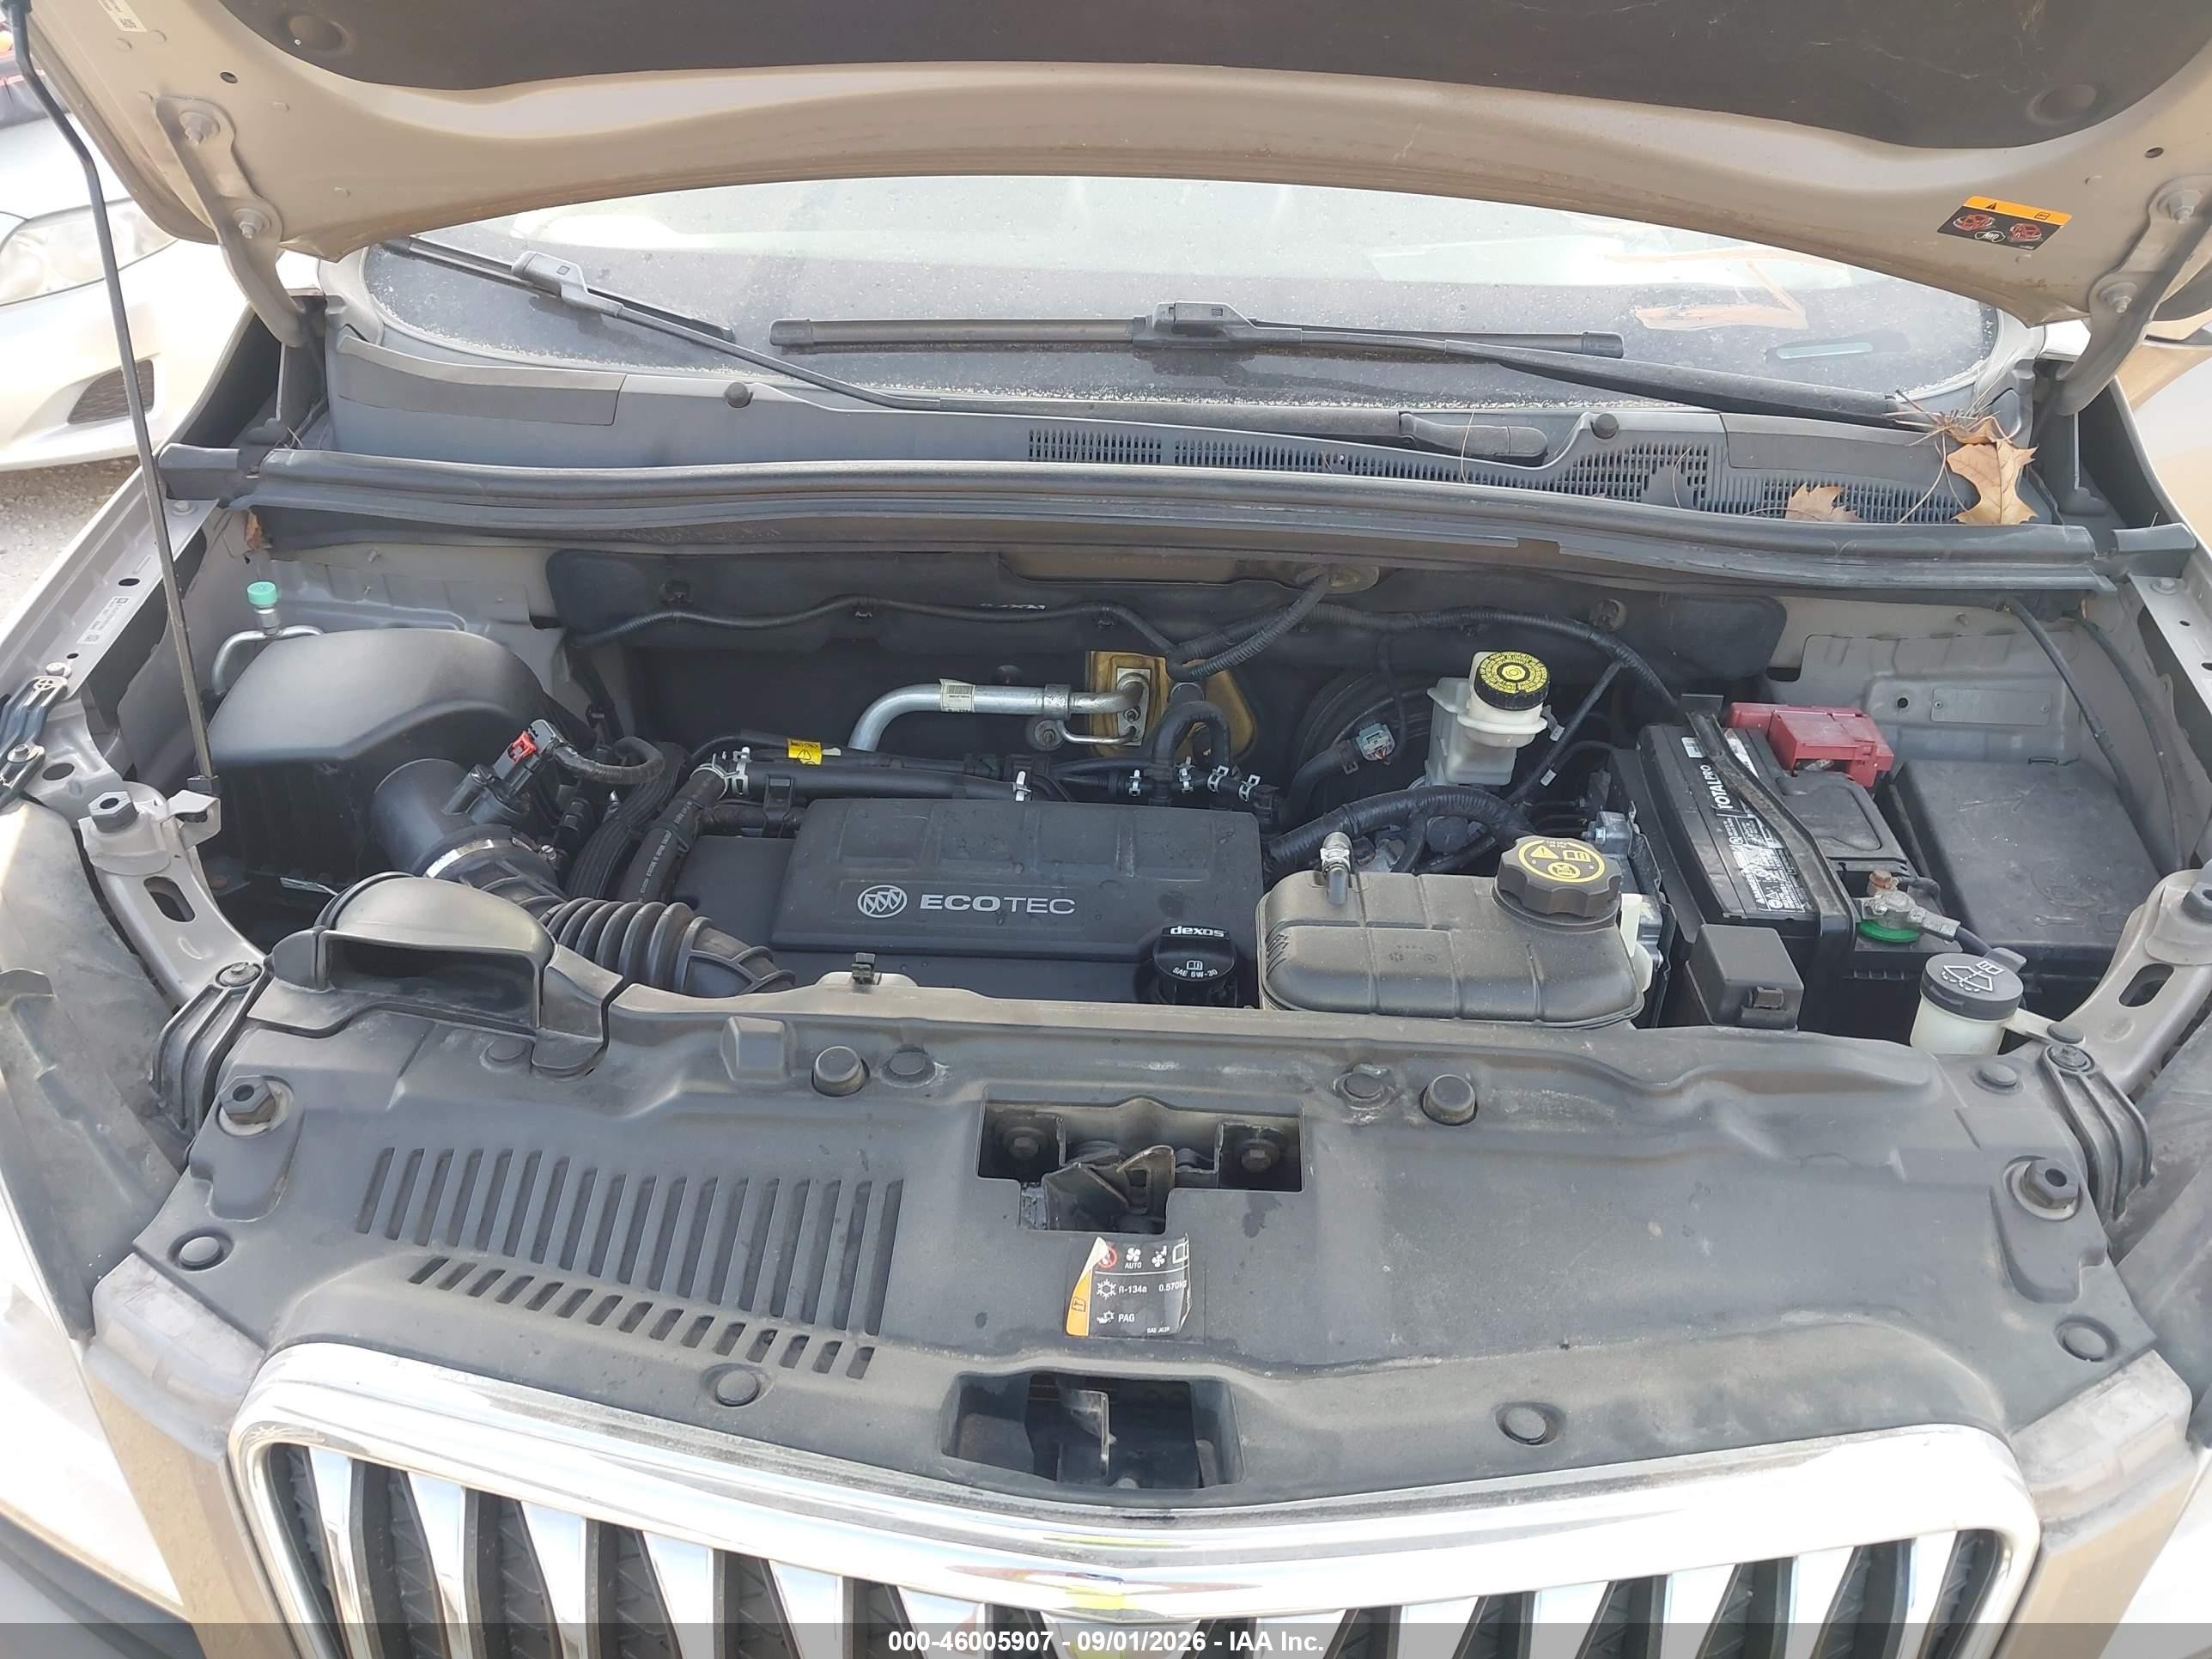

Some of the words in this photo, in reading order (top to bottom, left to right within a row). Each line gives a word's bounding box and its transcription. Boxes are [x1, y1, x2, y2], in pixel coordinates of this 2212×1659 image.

[920, 894, 1076, 915] ECOTEC
[1170, 925, 1225, 938] dexos
[1172, 967, 1188, 977] SAE
[1190, 969, 1218, 978] 5W-30
[1118, 1285, 1147, 1294] R-134a
[1118, 1313, 1135, 1322] PAG
